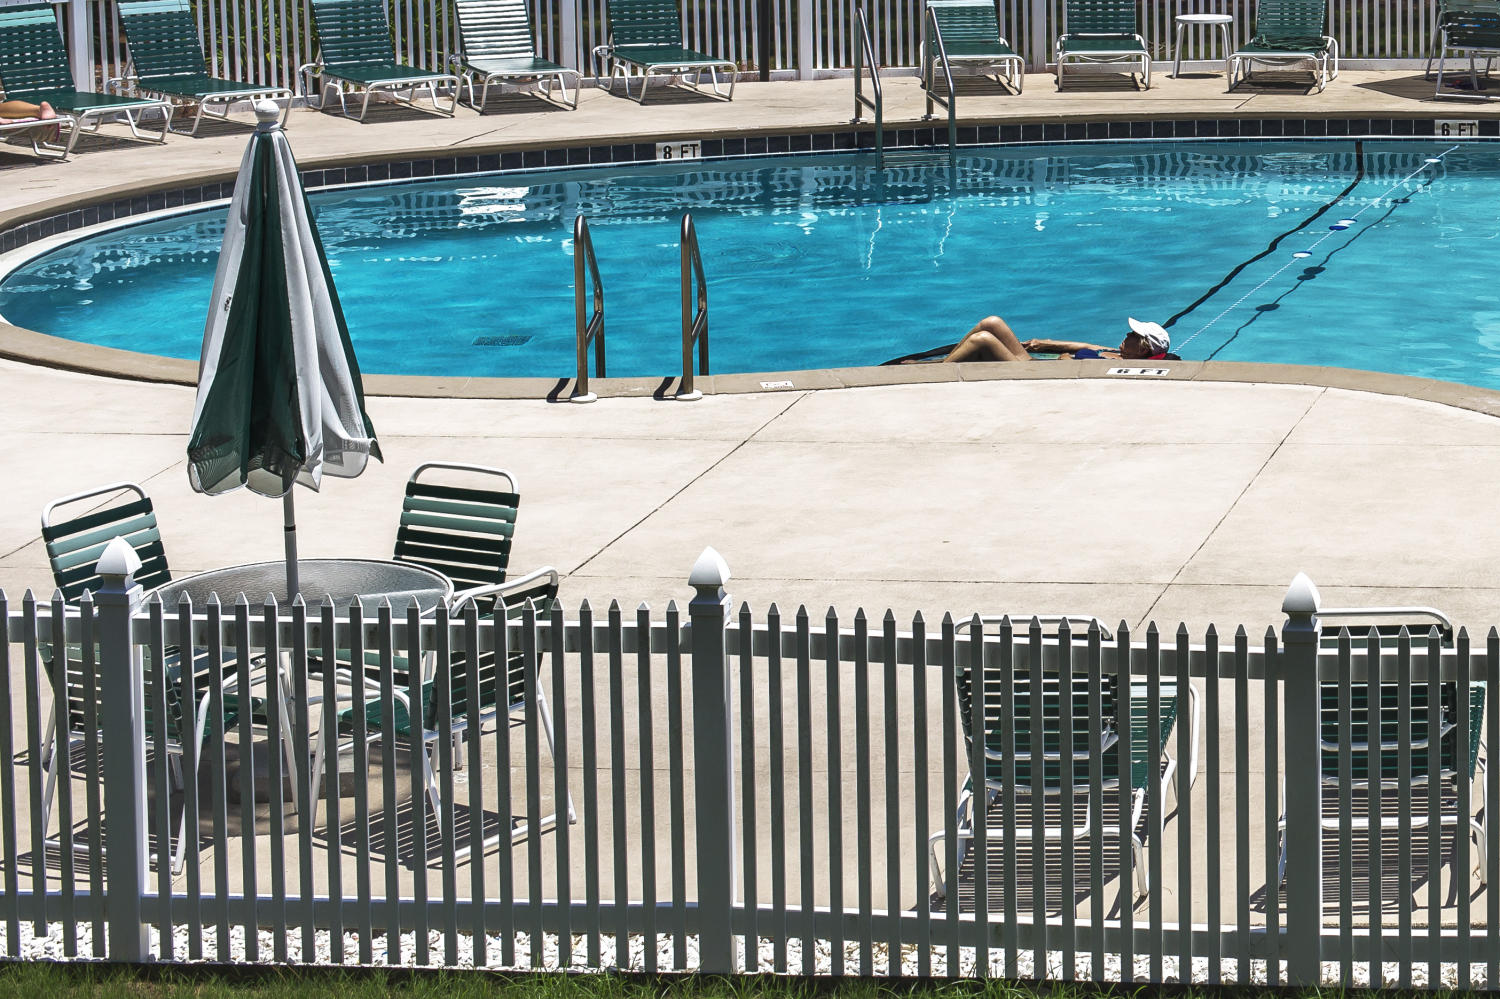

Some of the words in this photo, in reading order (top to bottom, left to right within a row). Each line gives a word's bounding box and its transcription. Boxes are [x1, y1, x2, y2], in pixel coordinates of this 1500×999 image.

[1441, 122, 1450, 136] 6
[1458, 122, 1477, 136] FT
[663, 145, 673, 159] 8
[680, 143, 699, 158] FT
